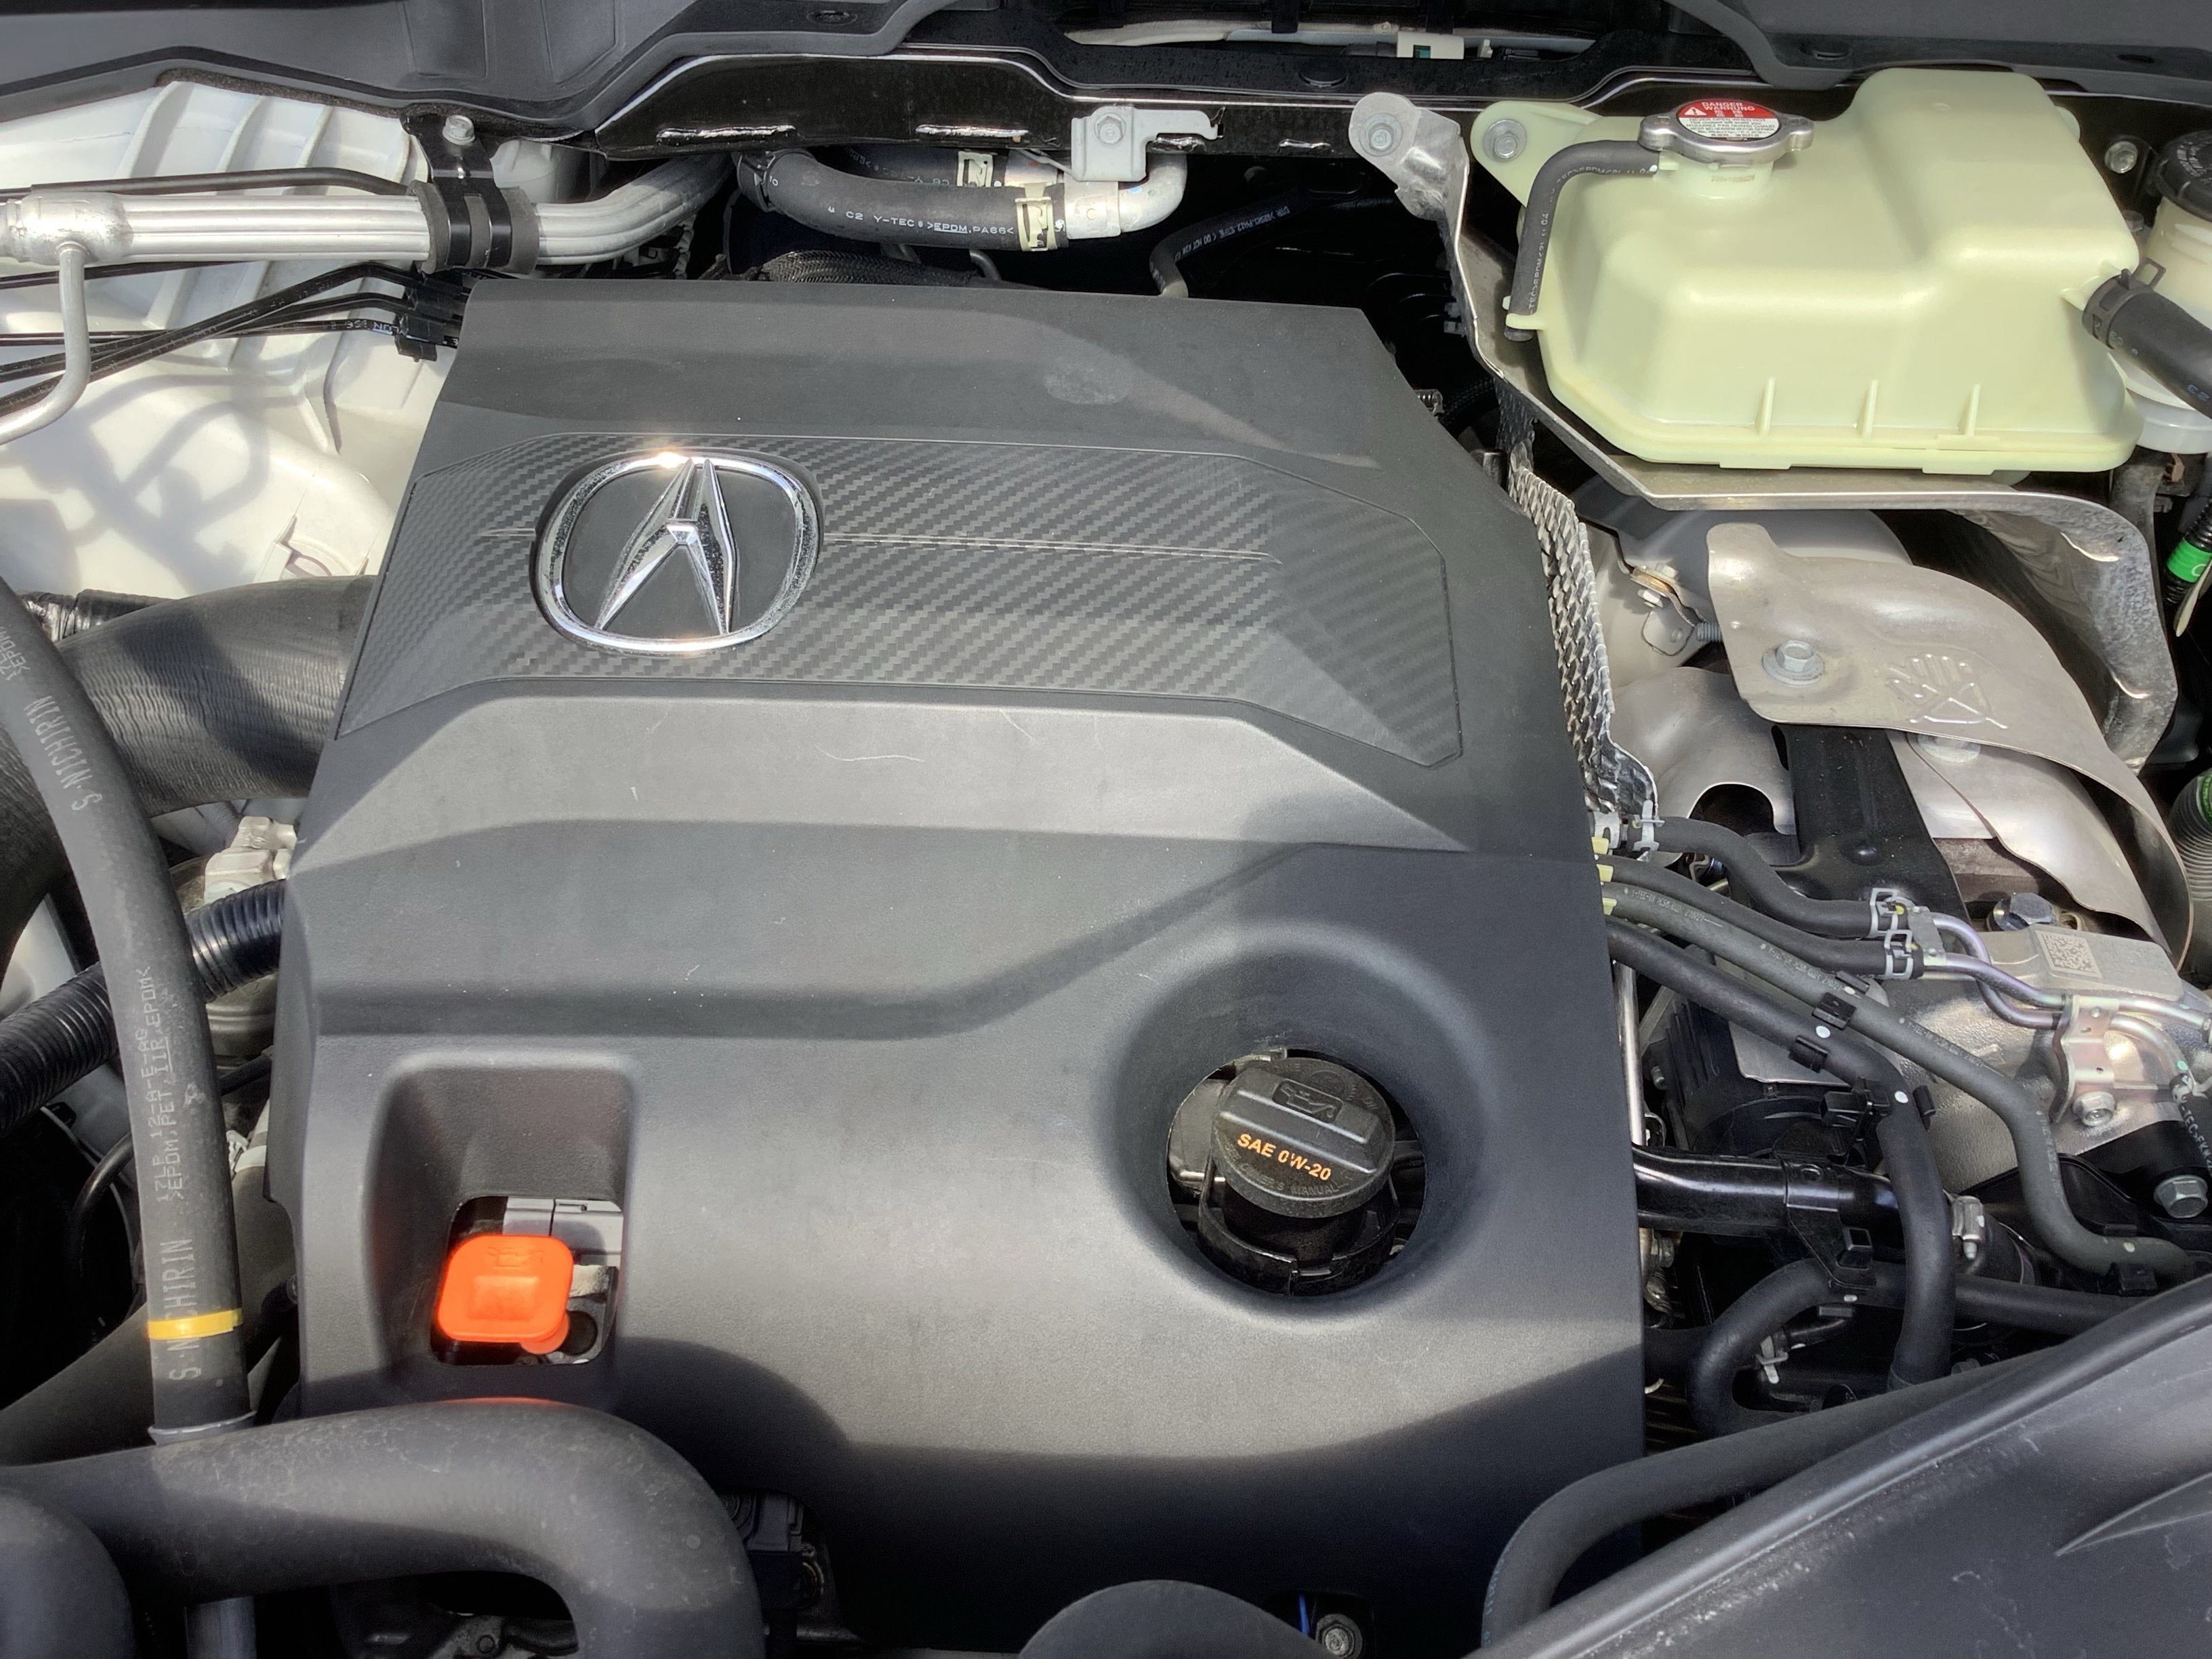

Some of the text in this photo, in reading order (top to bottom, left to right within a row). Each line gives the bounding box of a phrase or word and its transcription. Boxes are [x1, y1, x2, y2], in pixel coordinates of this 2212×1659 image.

[846, 210, 863, 220] C2
[873, 214, 915, 228] Y-TEC
[1237, 1132, 1333, 1181] SAE 0W-20
